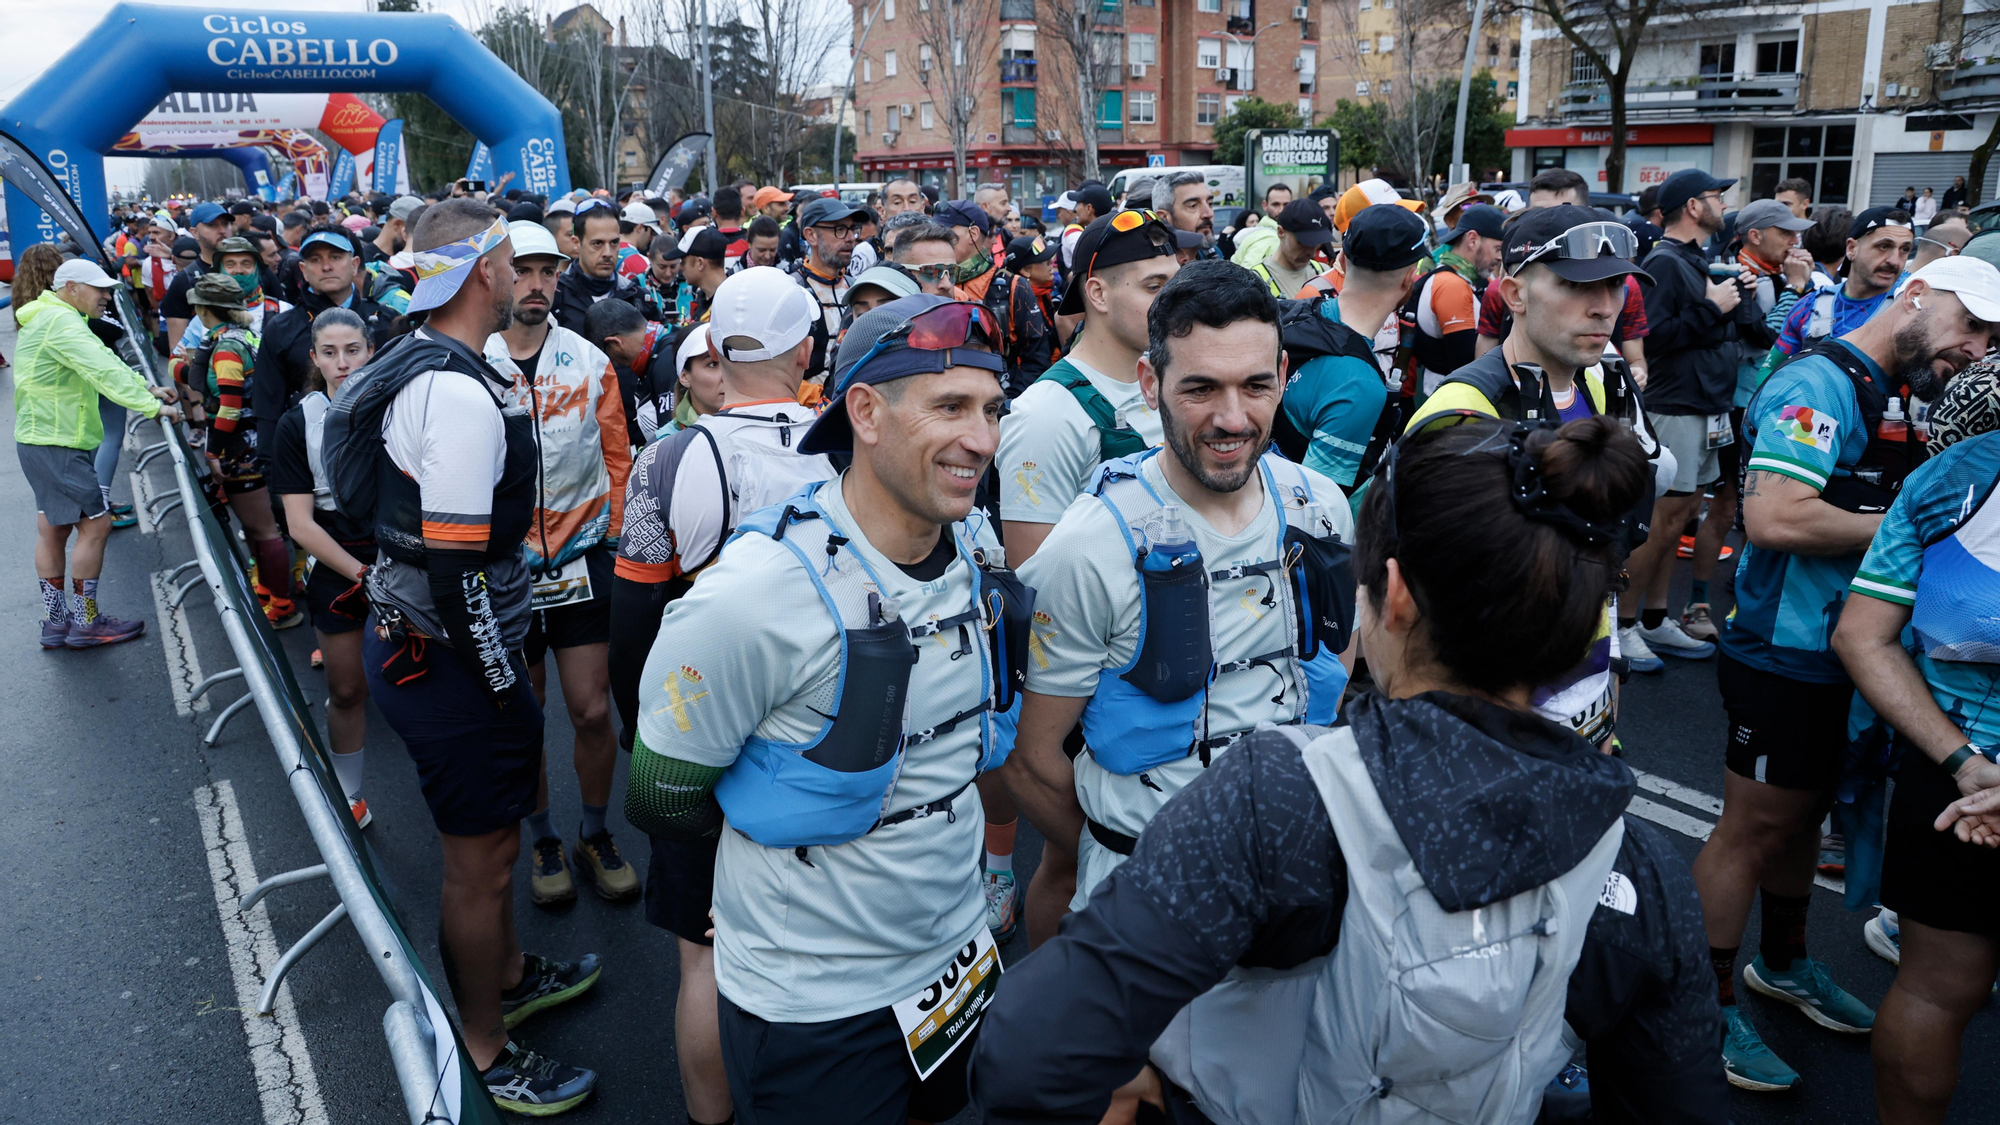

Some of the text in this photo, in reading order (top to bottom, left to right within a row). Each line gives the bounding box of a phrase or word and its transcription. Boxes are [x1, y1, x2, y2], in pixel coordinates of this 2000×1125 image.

[203, 14, 307, 35] Ciclos
[207, 37, 399, 66] CABELLO
[226, 68, 377, 80] CiclosCABELLO.COM
[158, 92, 258, 113] ALIDA
[1262, 135, 1329, 151] BARRIGAS
[386, 142, 396, 176] Ciclos
[542, 137, 558, 188] Ciclos
[1262, 151, 1328, 165] CERVECERAS
[332, 154, 347, 195] CABELLO
[1640, 171, 1652, 183] DE
[546, 593, 568, 602] RUNING
[921, 579, 948, 596] FILA
[874, 736, 886, 762] SOFT
[886, 685, 897, 704] 500
[945, 1016, 966, 1039] TRAIL
